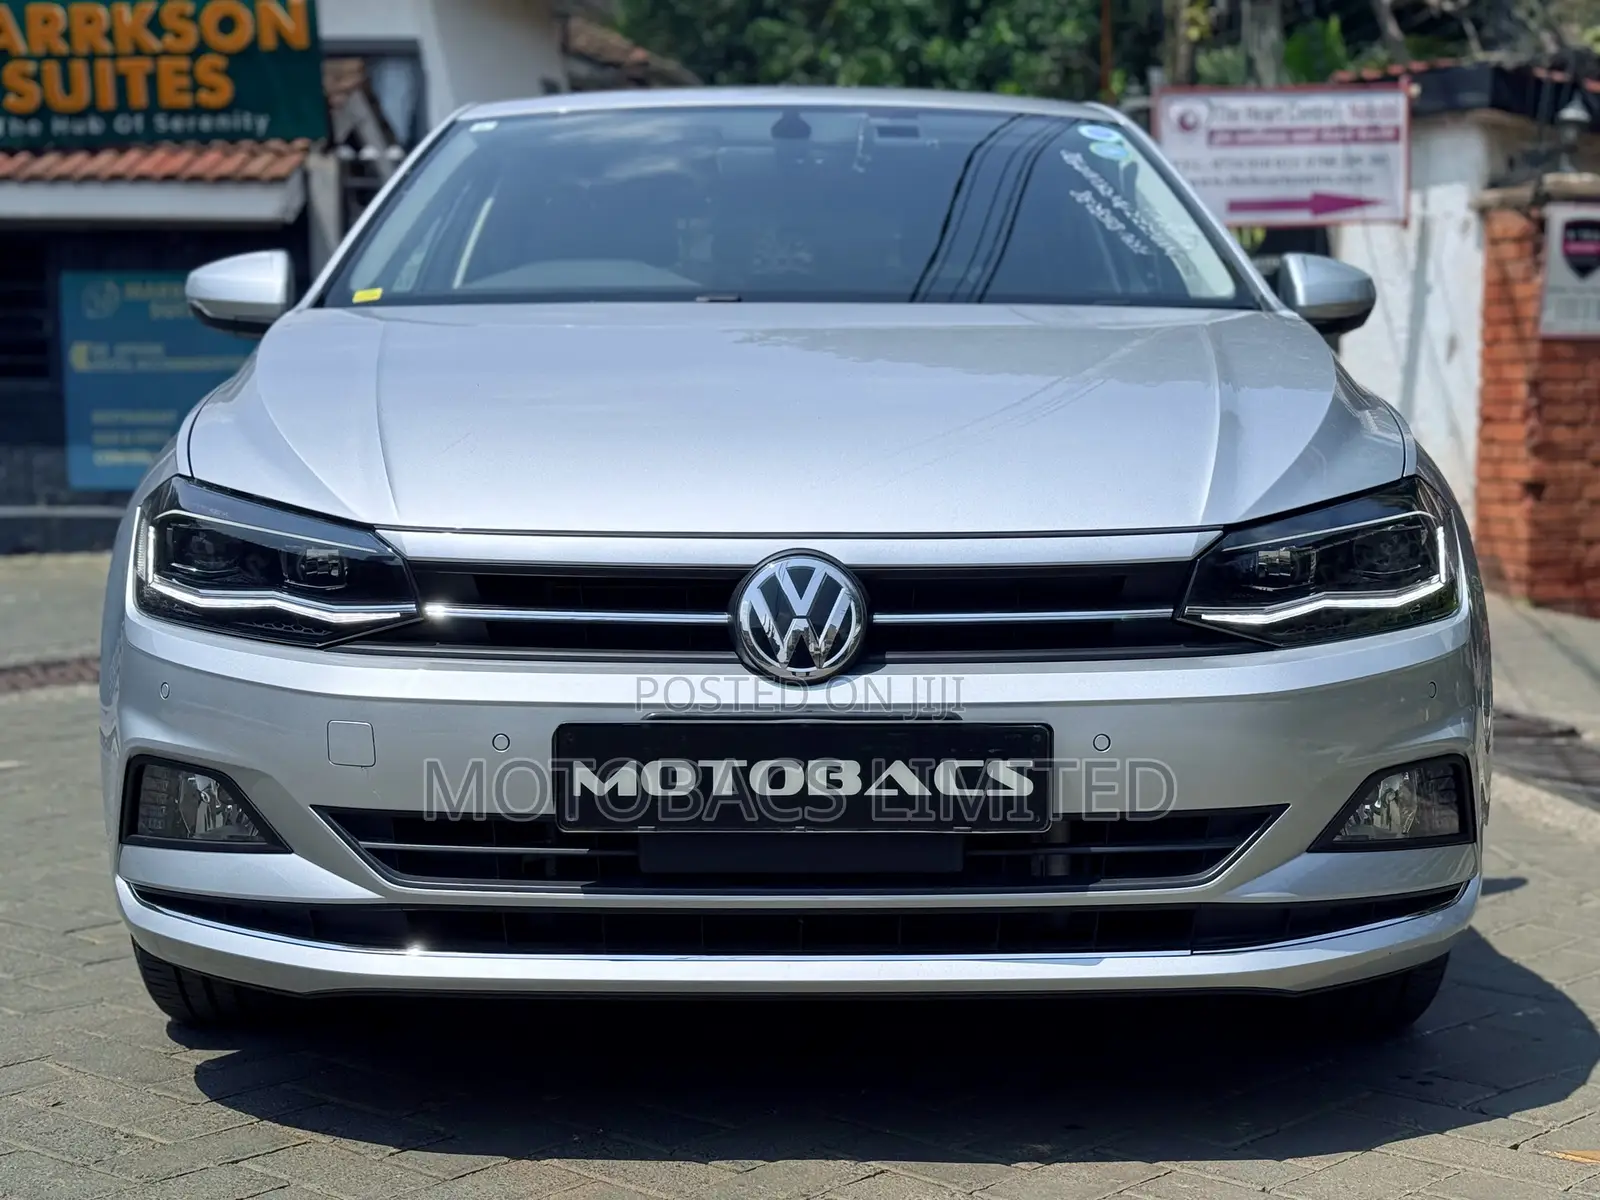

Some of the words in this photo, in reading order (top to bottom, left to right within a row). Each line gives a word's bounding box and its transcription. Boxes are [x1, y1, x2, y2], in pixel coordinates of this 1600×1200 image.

[2, 53, 235, 114] SUITES
[51, 114, 106, 135] Hub
[153, 109, 270, 137] Serenity
[573, 760, 1034, 796] MOTOBACS
